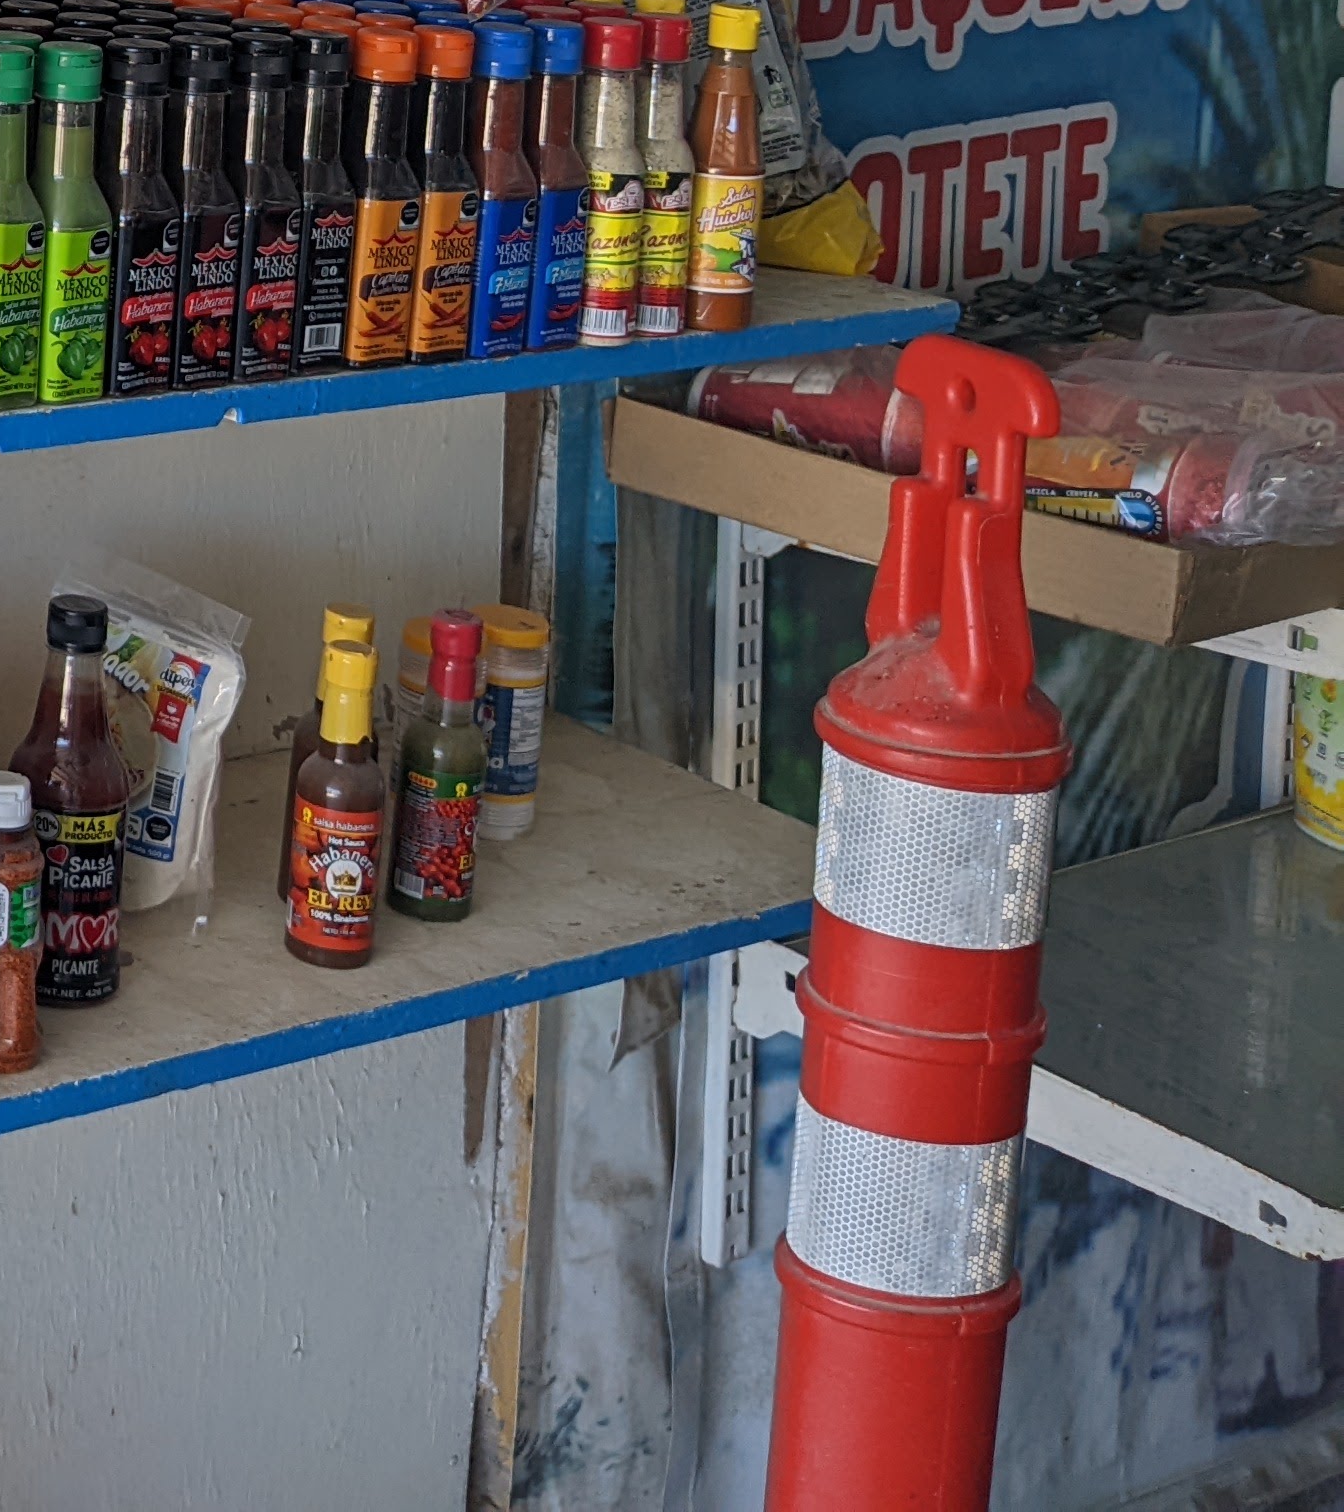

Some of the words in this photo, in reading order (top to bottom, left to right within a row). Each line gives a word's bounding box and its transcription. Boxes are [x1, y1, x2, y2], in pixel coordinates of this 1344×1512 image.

[722, 187, 756, 207] Salsa
[852, 116, 1108, 288] OTETE
[697, 203, 756, 234] Huichol
[56, 274, 108, 291] MÉXICO
[53, 313, 106, 333] Habanero
[1066, 489, 1098, 498] CERVEZA
[35, 817, 58, 833] 20%
[72, 817, 106, 833] MÁS
[64, 830, 113, 840] PRODUCTO
[308, 848, 376, 878] Habanero
[307, 887, 333, 910] EL
[337, 891, 372, 912] REY
[52, 958, 99, 975] PICANTE
